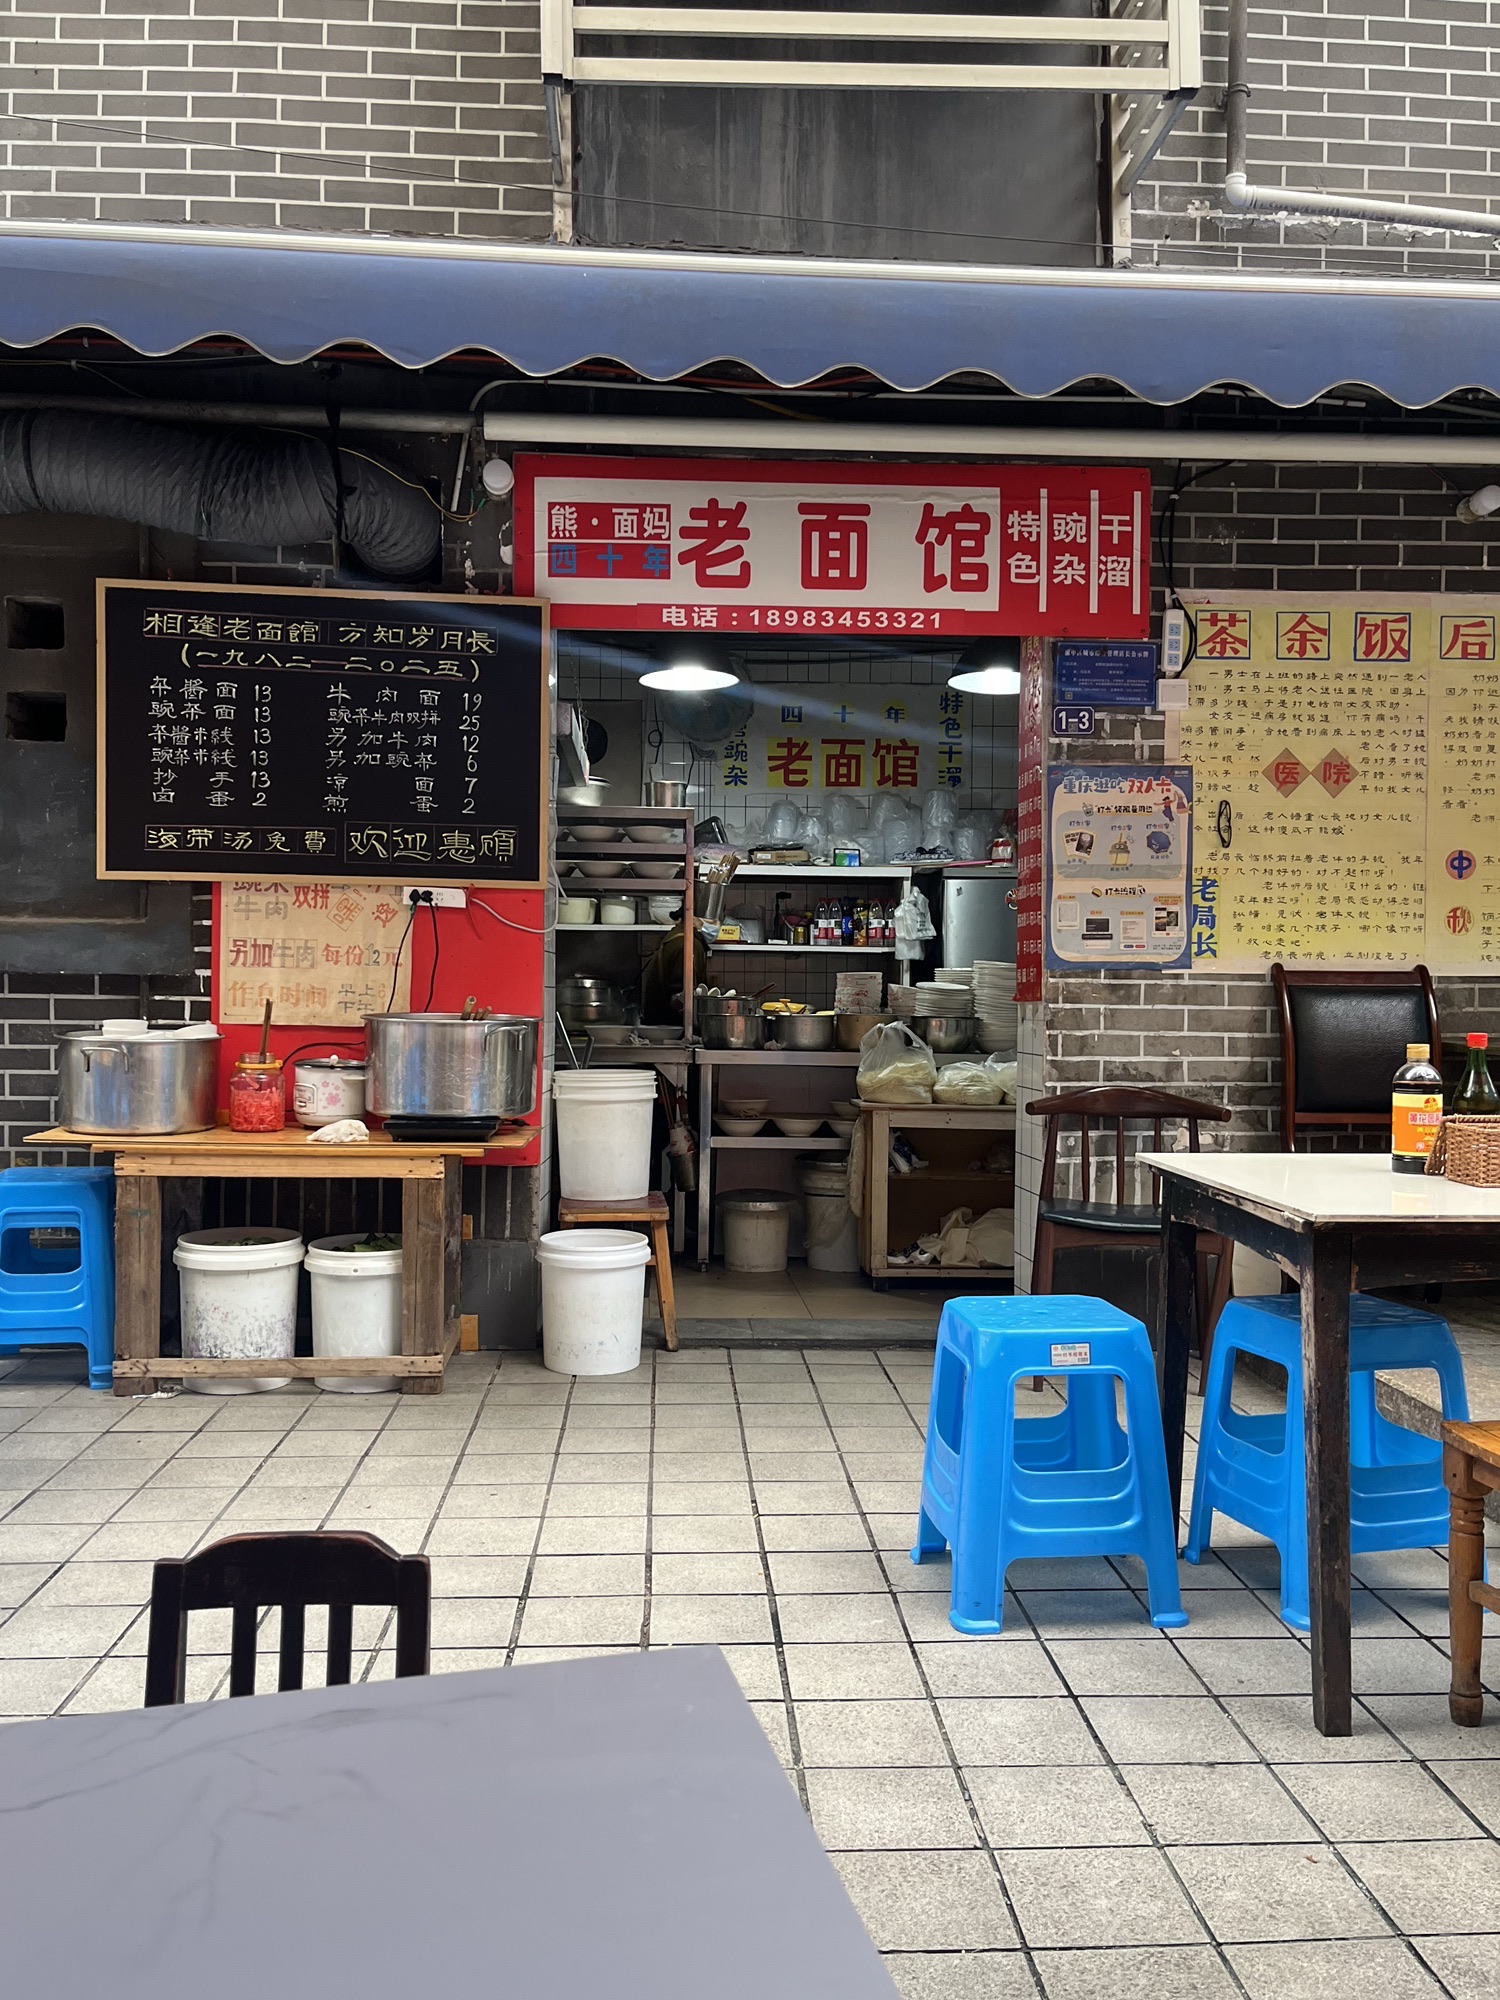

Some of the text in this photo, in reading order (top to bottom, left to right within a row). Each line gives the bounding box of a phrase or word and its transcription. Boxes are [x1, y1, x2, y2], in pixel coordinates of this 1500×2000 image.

[678, 498, 990, 593] 老面馆
[1007, 510, 1041, 584] 特色
[1053, 511, 1088, 585] 豌杂
[1099, 514, 1131, 587] 干溜
[551, 545, 670, 577] 四十年
[255, 684, 272, 703] 13
[326, 682, 482, 712] 牛肉面 19
[254, 706, 272, 723] 13
[458, 715, 480, 731] 25
[781, 704, 905, 723] 四十年
[1058, 711, 1090, 729] 1-3
[253, 728, 272, 745] 13
[325, 727, 480, 753] 另加牛肉 12
[250, 750, 269, 766] 13
[467, 754, 478, 772] 6
[767, 737, 919, 788] 老面馆
[251, 771, 271, 788] 13
[464, 777, 478, 794] 7
[252, 792, 267, 806] 2
[461, 798, 476, 814] 2
[233, 895, 289, 921] 牛肉
[1191, 875, 1219, 958] 老局长
